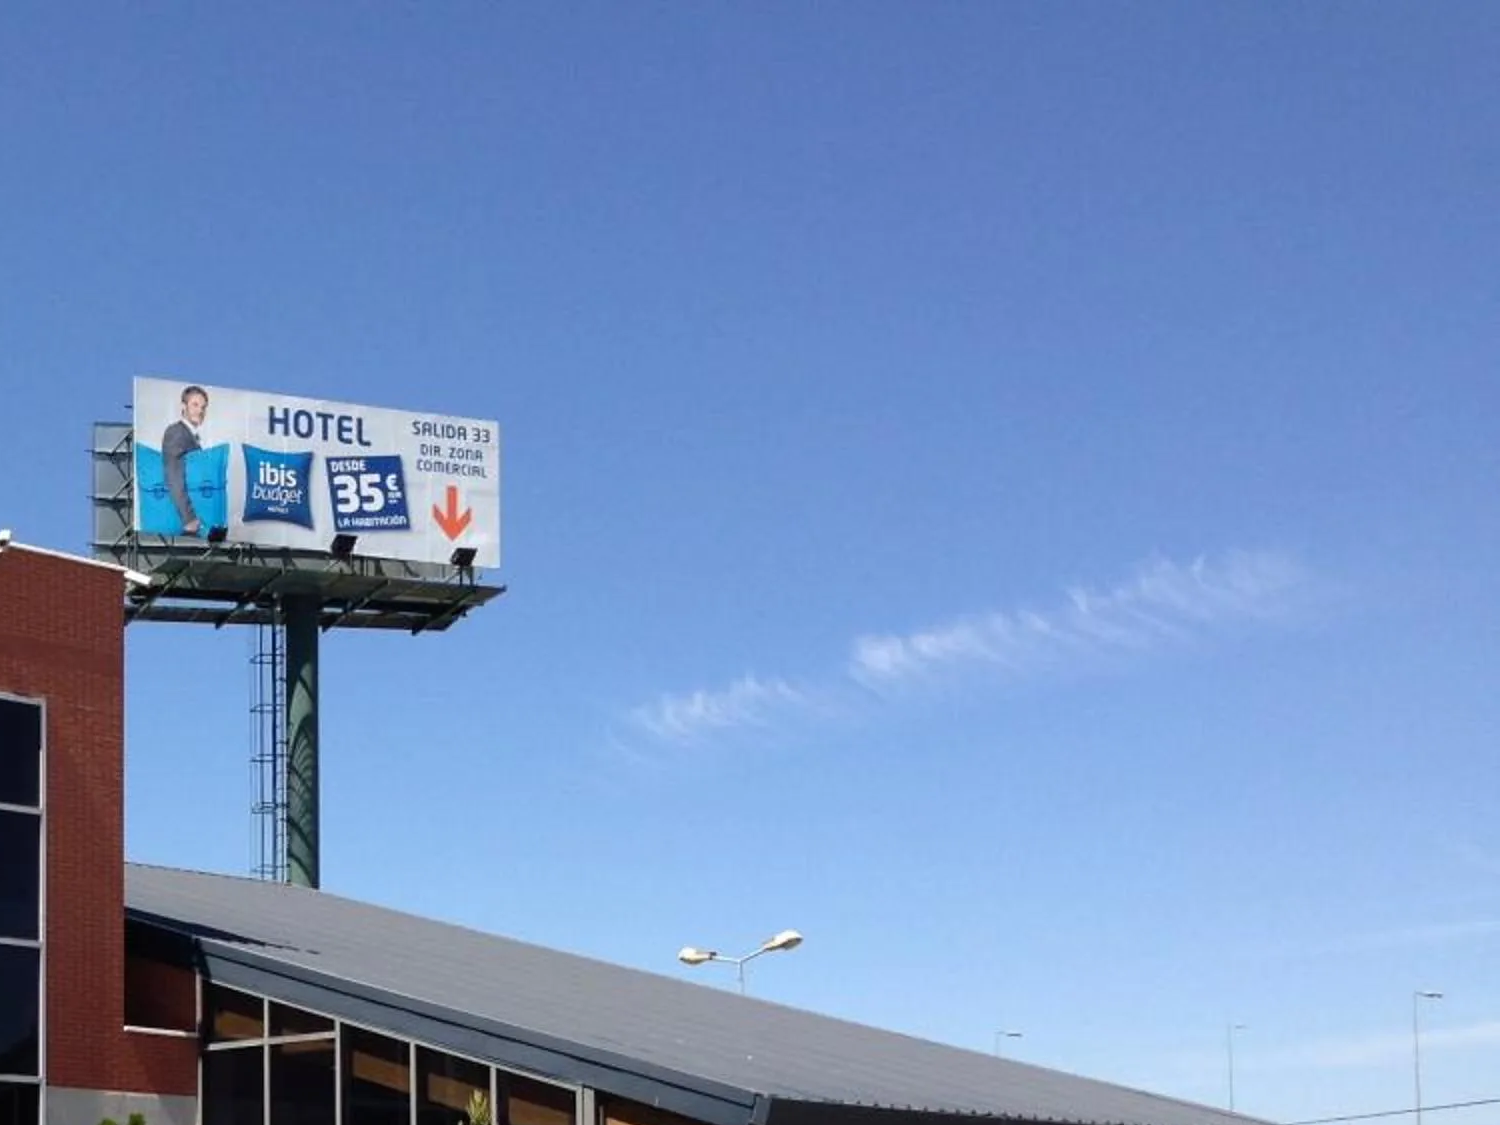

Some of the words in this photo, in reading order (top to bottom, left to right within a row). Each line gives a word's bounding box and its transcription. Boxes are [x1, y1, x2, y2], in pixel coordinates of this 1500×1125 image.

[268, 405, 372, 447] HOTEL
[412, 420, 467, 440] SALIDA
[472, 427, 491, 443] 33
[331, 459, 366, 472] DESDE
[449, 447, 483, 461] ZONA
[259, 461, 297, 487] ibis
[417, 459, 488, 479] COMERCIAL
[252, 482, 303, 506] budget
